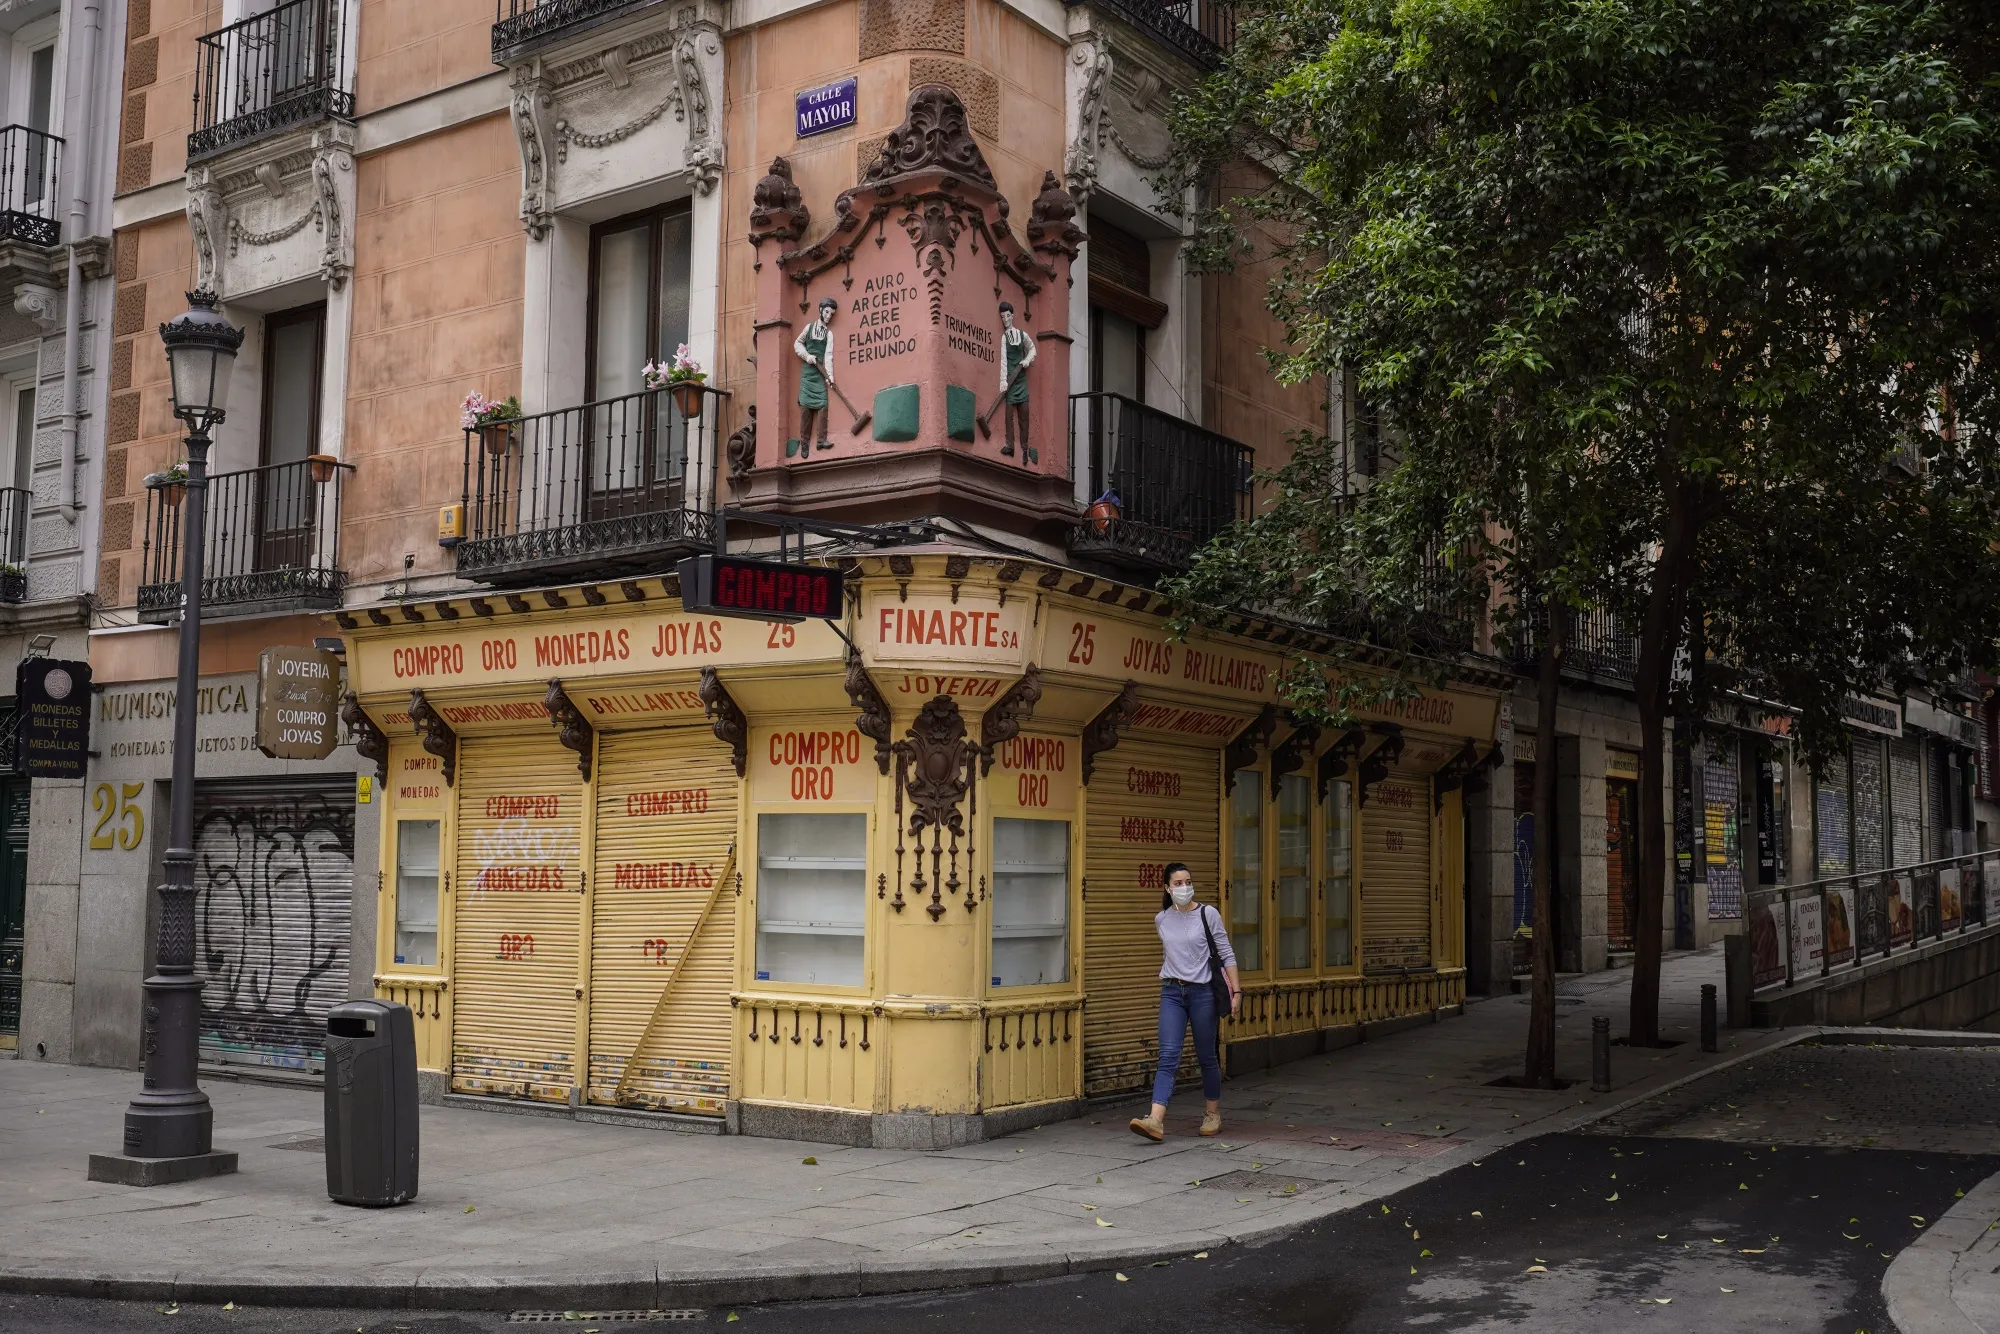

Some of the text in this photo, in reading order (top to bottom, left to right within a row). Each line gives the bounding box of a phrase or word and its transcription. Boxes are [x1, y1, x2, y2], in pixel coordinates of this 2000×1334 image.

[809, 86, 842, 105] CALLE
[800, 100, 851, 131] MAYOR
[865, 272, 905, 293] AURO
[859, 307, 900, 328] AERE
[944, 313, 992, 345] TRIUMVIRIS
[849, 324, 901, 348] FLANDO
[849, 338, 917, 365] FERIUNDO
[948, 335, 995, 364] MONETALIS
[718, 566, 829, 614] COMPRO
[879, 608, 1018, 649] FINARTE SA
[393, 620, 795, 678] COMPRO ORO MONEDAS JOYAS 25
[1068, 621, 1096, 666] 25
[1123, 637, 1173, 675] JOYAS
[1183, 648, 1266, 693] BRILLANTES
[277, 659, 330, 680] JOYERIA
[898, 675, 1001, 698] JOYERIA
[31, 703, 82, 716] MONEDAS
[101, 684, 249, 722] NUMISMTICA
[443, 704, 501, 724] COMPRO
[588, 690, 705, 715] BRILLANTES
[33, 717, 79, 729] BILLETES
[277, 708, 327, 726] COMPRO
[1169, 710, 1244, 737] MONEDAS
[29, 739, 80, 751] MEDALLAS
[52, 729, 60, 739] Y
[279, 728, 323, 745] JOYAS
[110, 741, 166, 758] MONEDAS
[196, 737, 236, 753] JETOS
[769, 731, 860, 766] COMPRO
[1002, 735, 1065, 772] COMPRO
[28, 759, 79, 769] COMPRA-VENTA
[404, 758, 437, 770] COMPRO
[400, 786, 440, 799] MONEDAS
[791, 766, 833, 800] ORO
[1018, 772, 1049, 807] ORO
[1127, 766, 1180, 797] COMPRO
[485, 795, 559, 819] COMPRO
[626, 788, 708, 817] COMPRO
[1376, 784, 1413, 809] COMPRO
[89, 781, 145, 851] 25
[1120, 816, 1184, 845] MONEDAS
[1386, 830, 1404, 852] ORO
[477, 865, 564, 892] MONEDAS
[614, 861, 714, 890] MONEDAS
[1139, 862, 1164, 889] ORO
